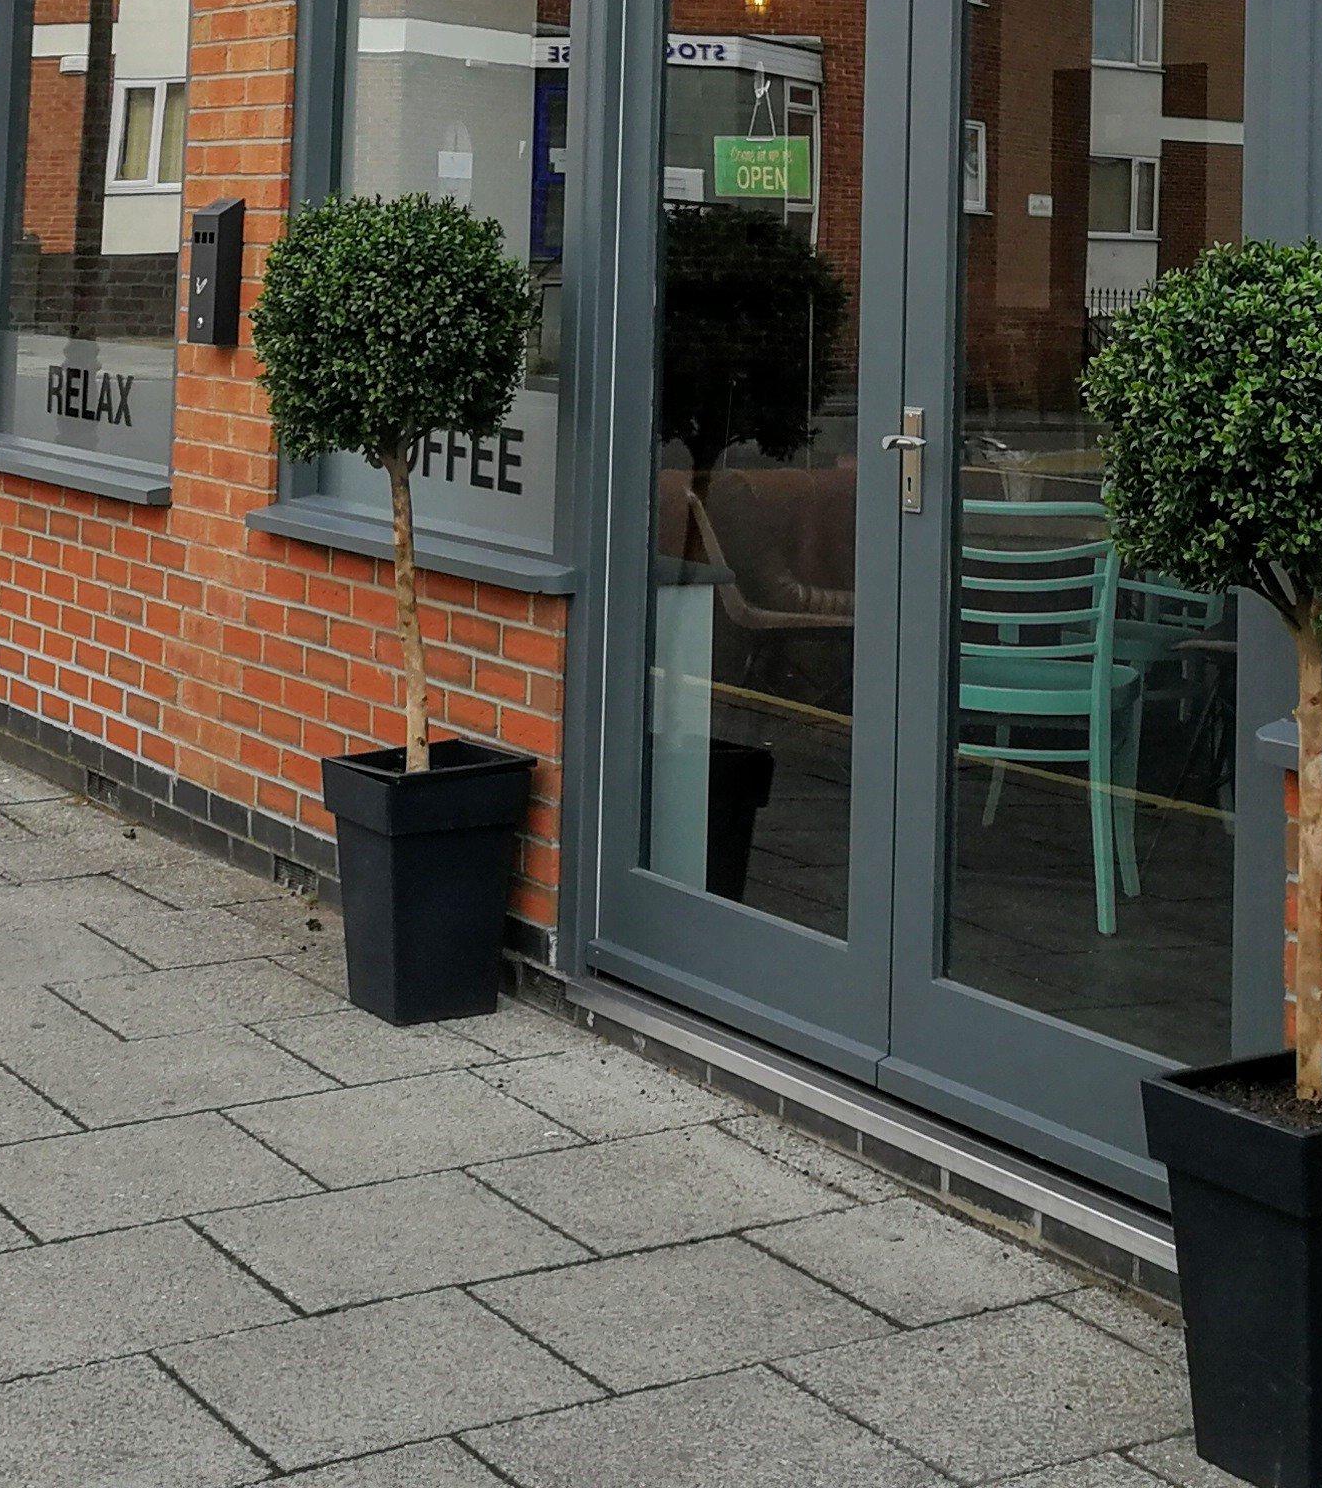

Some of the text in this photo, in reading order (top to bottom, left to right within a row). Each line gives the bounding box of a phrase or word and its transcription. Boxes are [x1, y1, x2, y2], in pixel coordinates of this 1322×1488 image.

[737, 165, 788, 191] OPEN
[47, 365, 134, 428] RELAX
[366, 426, 524, 495] FFEE
